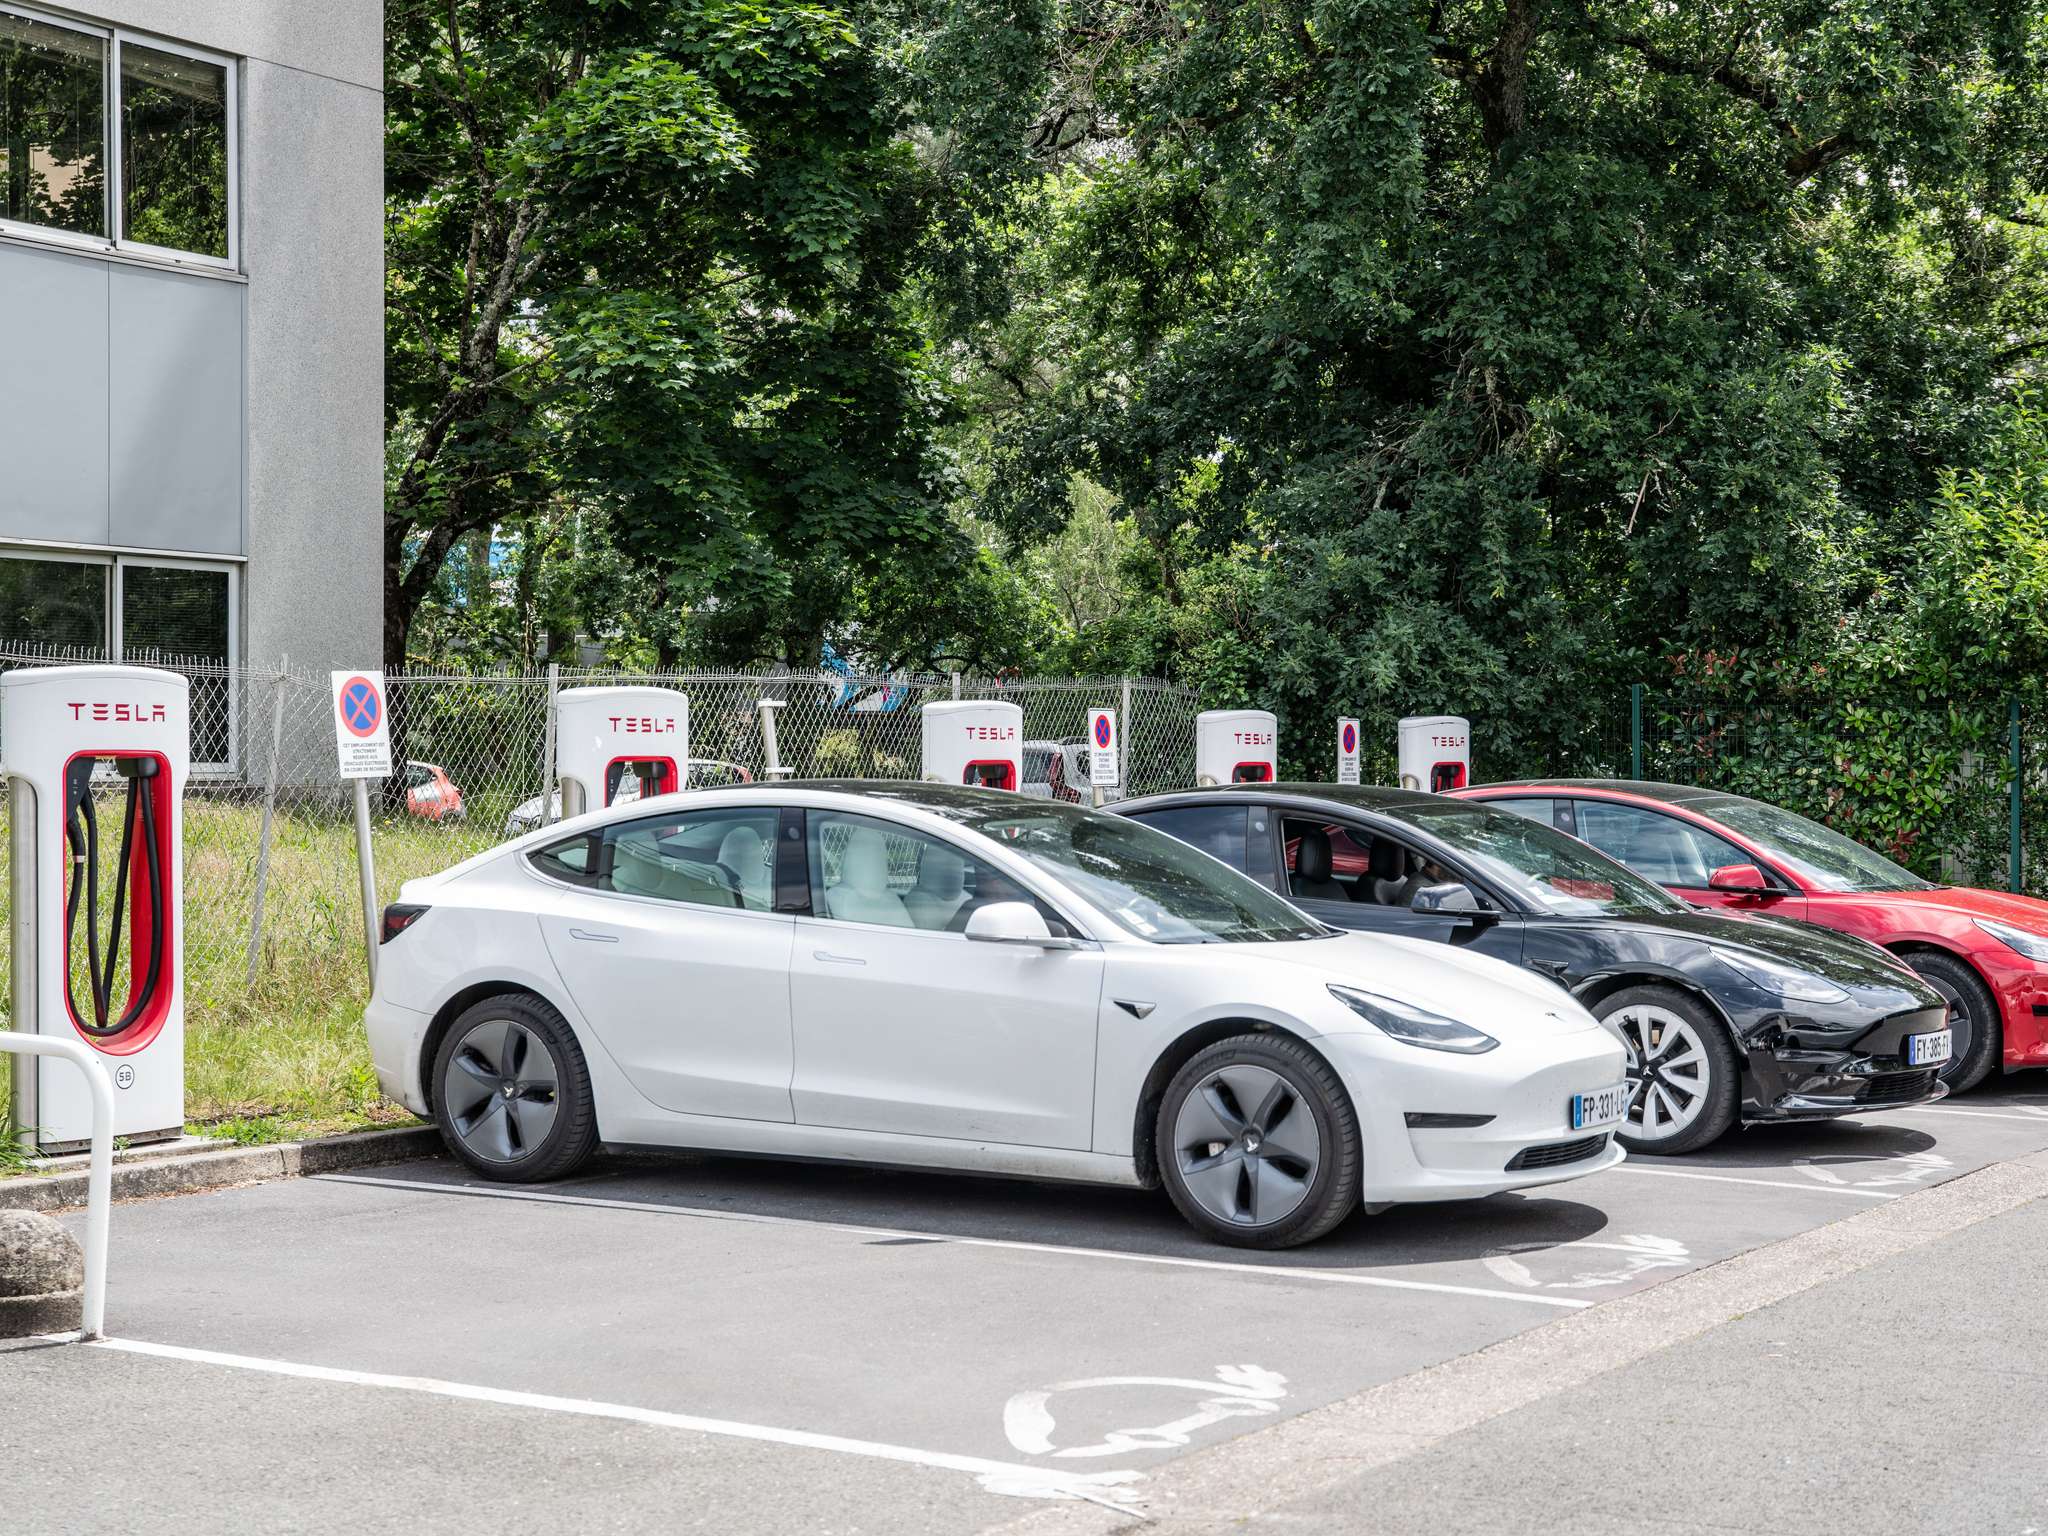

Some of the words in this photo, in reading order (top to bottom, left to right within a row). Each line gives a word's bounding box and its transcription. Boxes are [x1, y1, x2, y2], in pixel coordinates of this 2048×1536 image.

[67, 703, 165, 722] TESLA
[608, 717, 675, 733] TESLA
[966, 727, 1014, 740] TESLA
[1234, 733, 1272, 745] TESLA
[1432, 736, 1465, 747] TESLA
[119, 1071, 132, 1082] 5B
